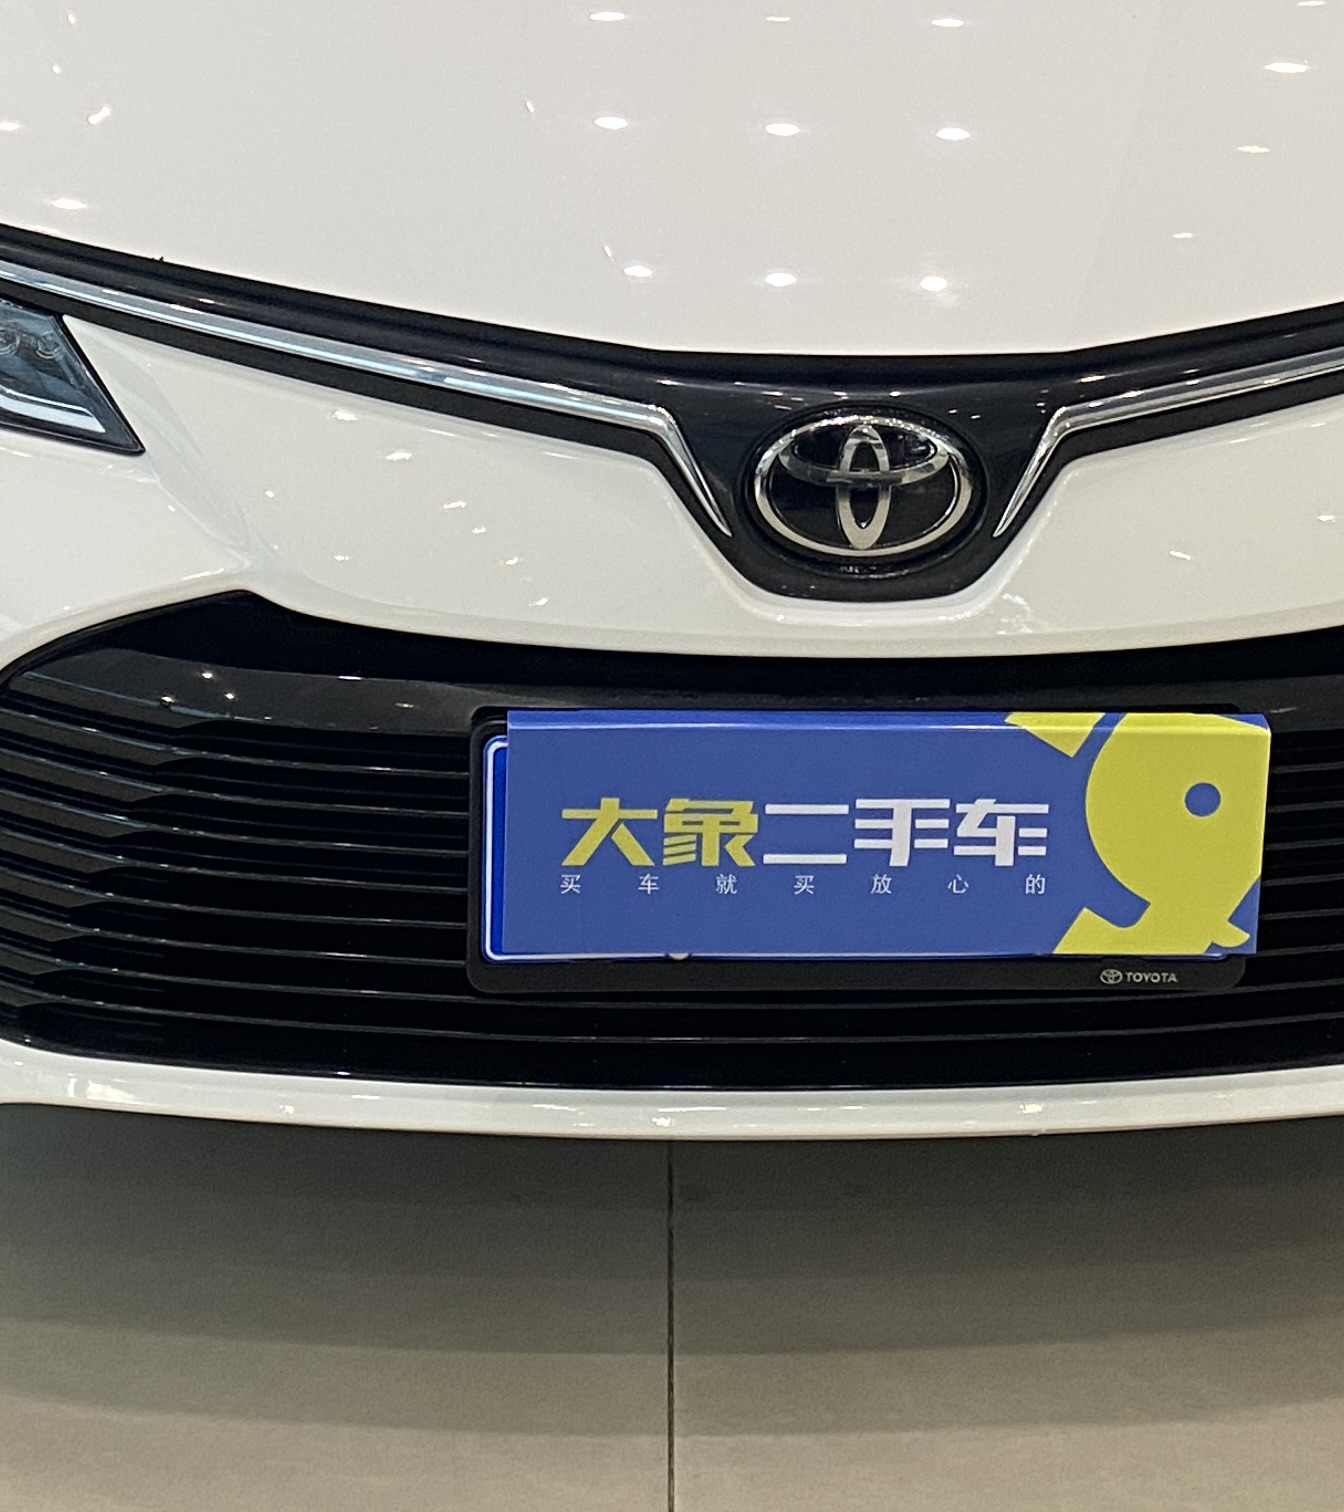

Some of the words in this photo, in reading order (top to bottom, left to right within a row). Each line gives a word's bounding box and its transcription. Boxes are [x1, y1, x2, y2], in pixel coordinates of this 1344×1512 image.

[561, 797, 1050, 867] 大象二手车
[559, 873, 1047, 896] 买车就买放心的
[1124, 972, 1178, 983] TOYOTA
